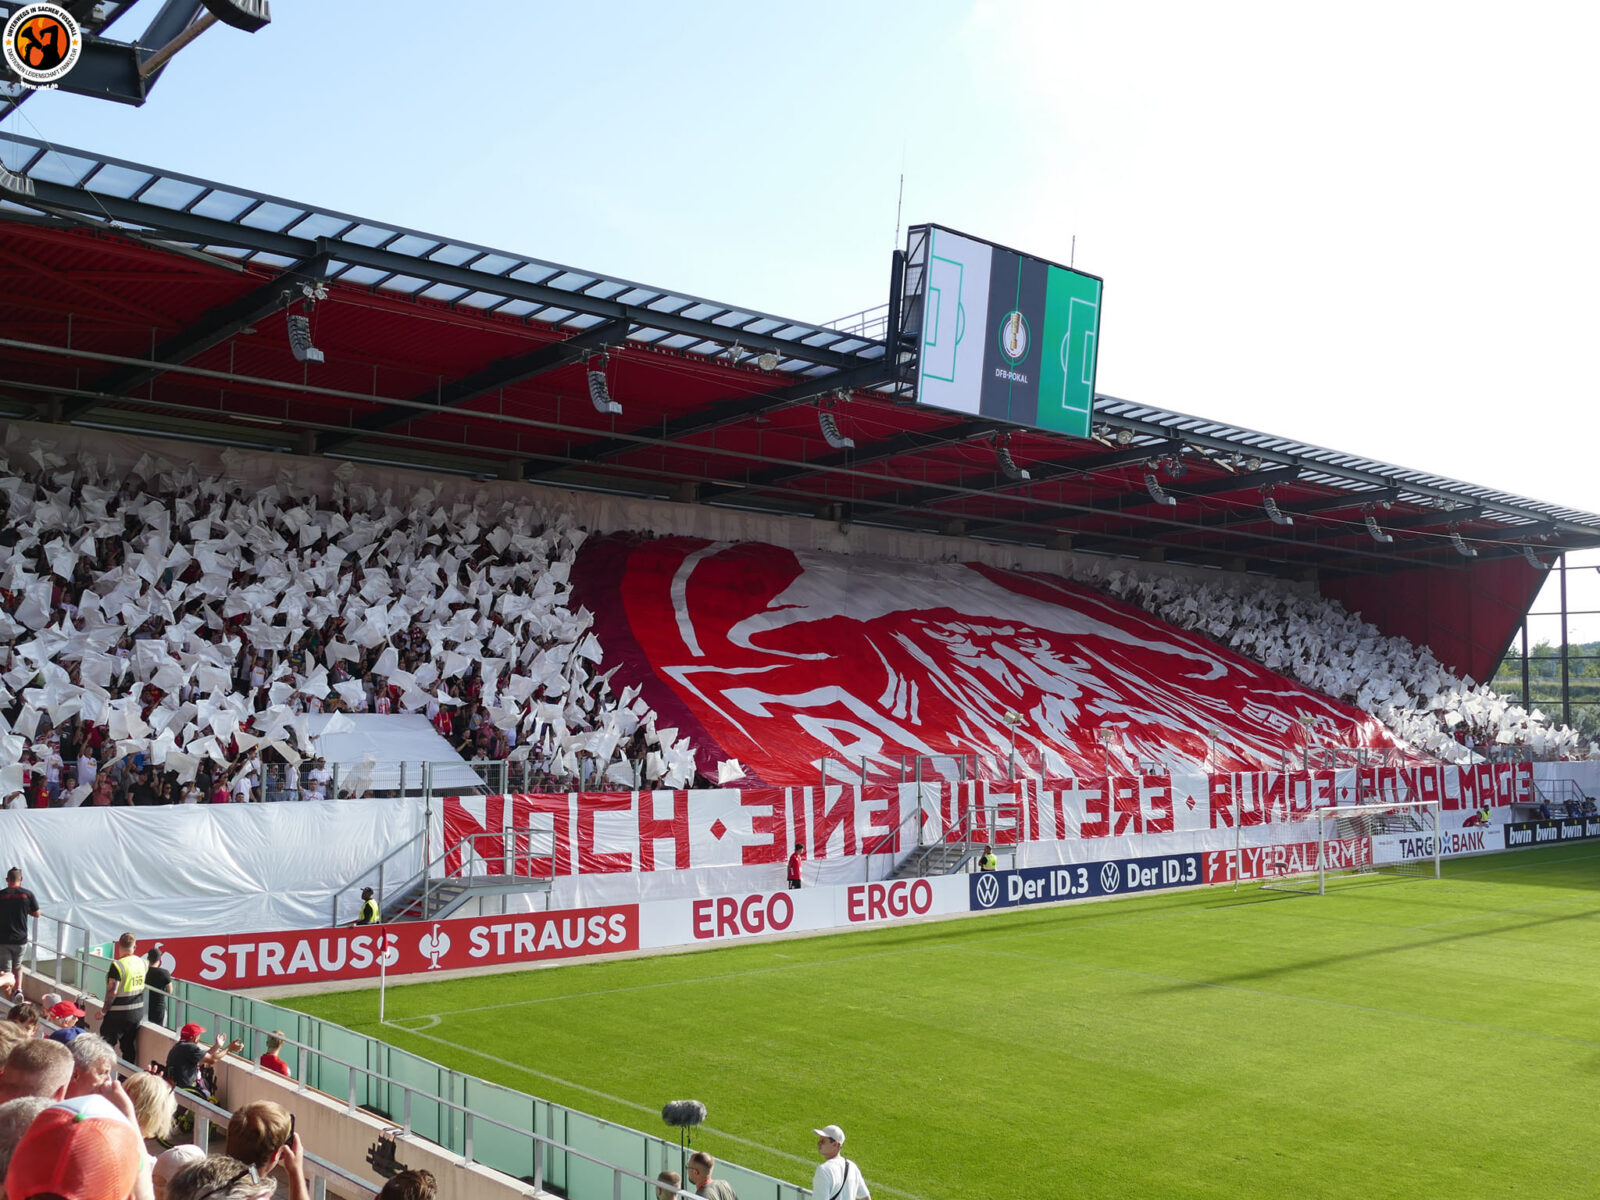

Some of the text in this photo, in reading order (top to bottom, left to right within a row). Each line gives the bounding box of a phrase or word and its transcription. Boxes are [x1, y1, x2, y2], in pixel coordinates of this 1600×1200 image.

[995, 368, 1028, 384] DFB-POKAL
[443, 789, 691, 878] NOCH
[740, 784, 901, 866] EINE
[940, 775, 1175, 845] WEITERE
[1208, 769, 1336, 830] RUNDE
[1509, 824, 1532, 845] bwin
[1535, 821, 1557, 842] bwin
[1561, 819, 1582, 839] bwin
[1008, 874, 1046, 902] Der
[1050, 868, 1089, 897] ID.3
[1127, 863, 1159, 888] Der
[1162, 857, 1197, 884] ID.3
[1225, 841, 1356, 881] FLYERALARM
[693, 878, 933, 940] ERGO ERGO
[199, 913, 627, 982] STRAUSS STRAUSS
